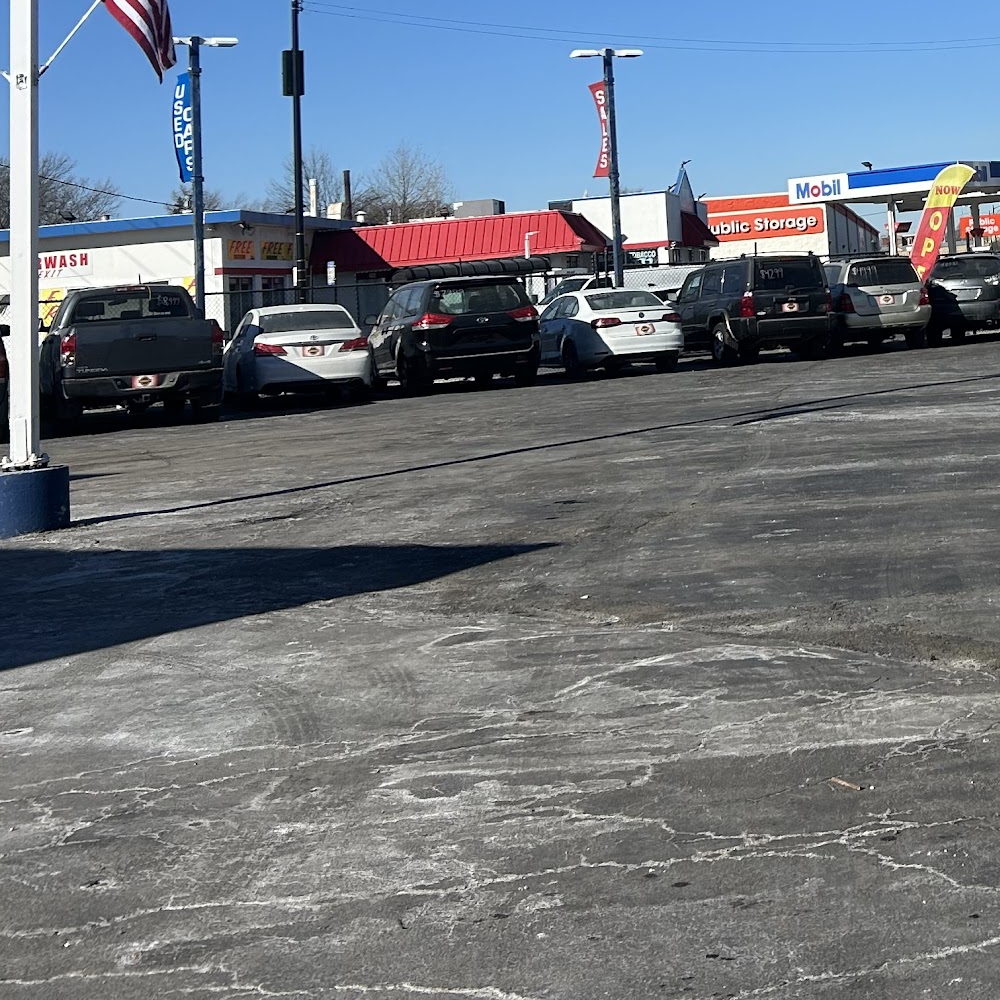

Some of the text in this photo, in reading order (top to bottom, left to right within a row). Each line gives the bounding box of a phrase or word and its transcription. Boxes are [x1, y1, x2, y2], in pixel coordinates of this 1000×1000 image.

[173, 83, 186, 149] USED
[595, 89, 608, 169] SALES
[795, 178, 841, 200] Mobil
[935, 185, 961, 195] NOW
[709, 215, 817, 236] ublic Storage
[968, 217, 996, 226] Pblic
[229, 240, 253, 254] FREE
[262, 242, 282, 255] FREE
[629, 249, 656, 259] TOBACCO
[38, 269, 63, 279] EXIT
[759, 267, 784, 280] $4299
